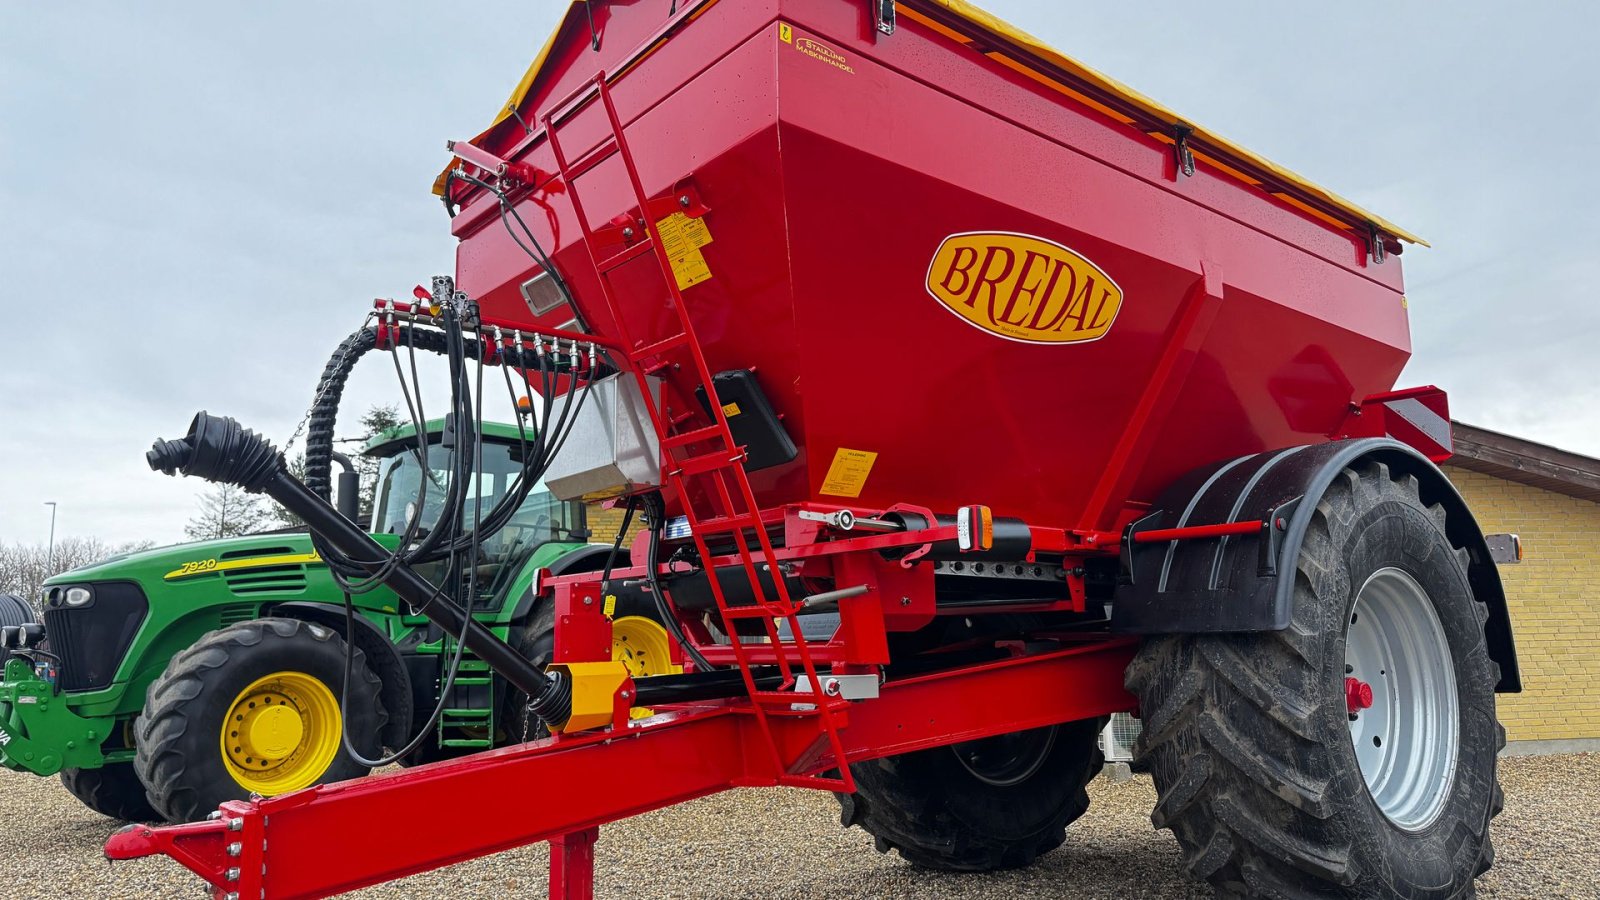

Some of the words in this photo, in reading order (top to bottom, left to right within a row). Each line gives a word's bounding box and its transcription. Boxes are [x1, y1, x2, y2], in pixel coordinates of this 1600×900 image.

[796, 45, 855, 75] MASKINHANDEL
[806, 40, 845, 62] STAULUND
[940, 246, 1112, 332] BREDAL
[182, 558, 217, 573] 7920
